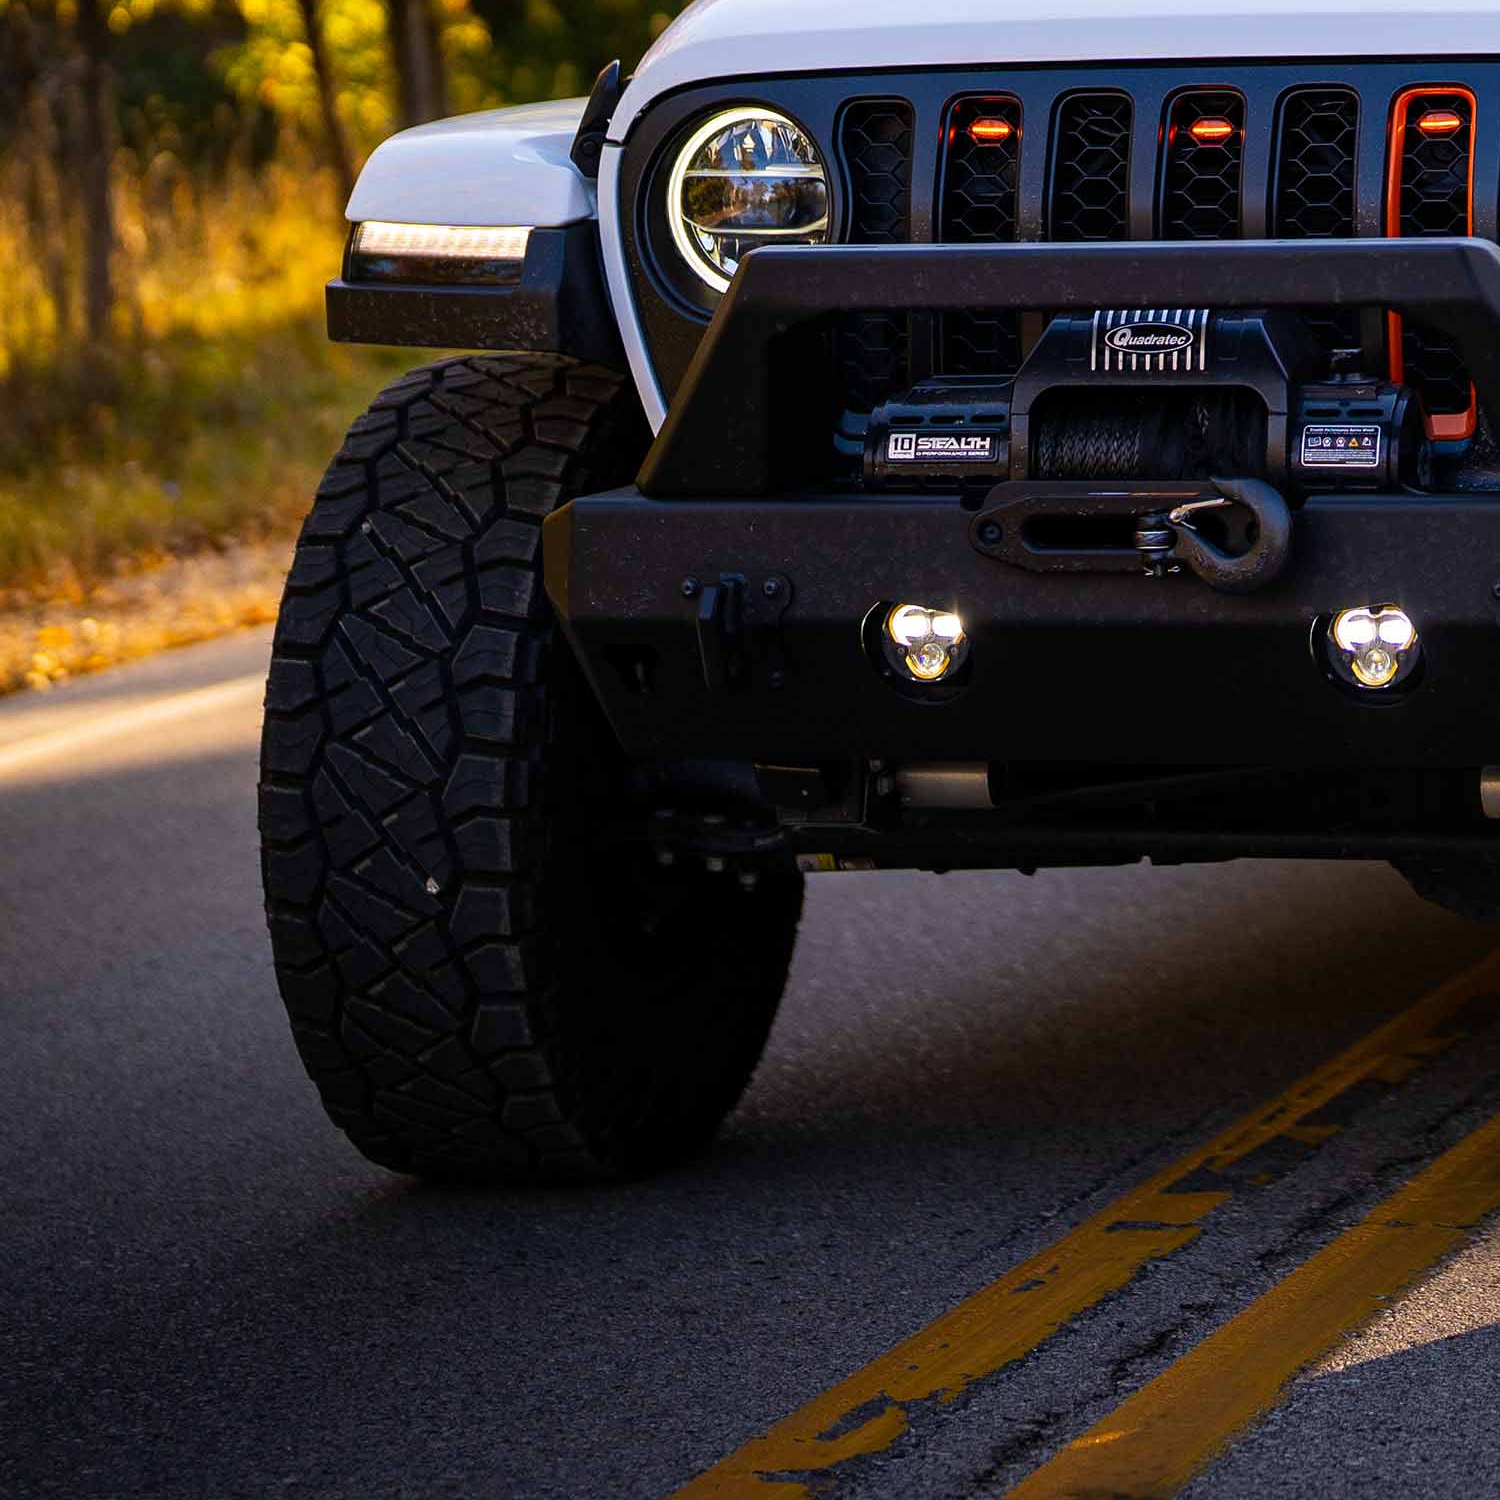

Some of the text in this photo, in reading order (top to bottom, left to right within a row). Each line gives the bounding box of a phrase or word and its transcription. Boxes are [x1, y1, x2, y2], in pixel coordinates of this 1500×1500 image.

[1113, 328, 1187, 346] Quadratec
[894, 437, 991, 451] 10 STEALTH
